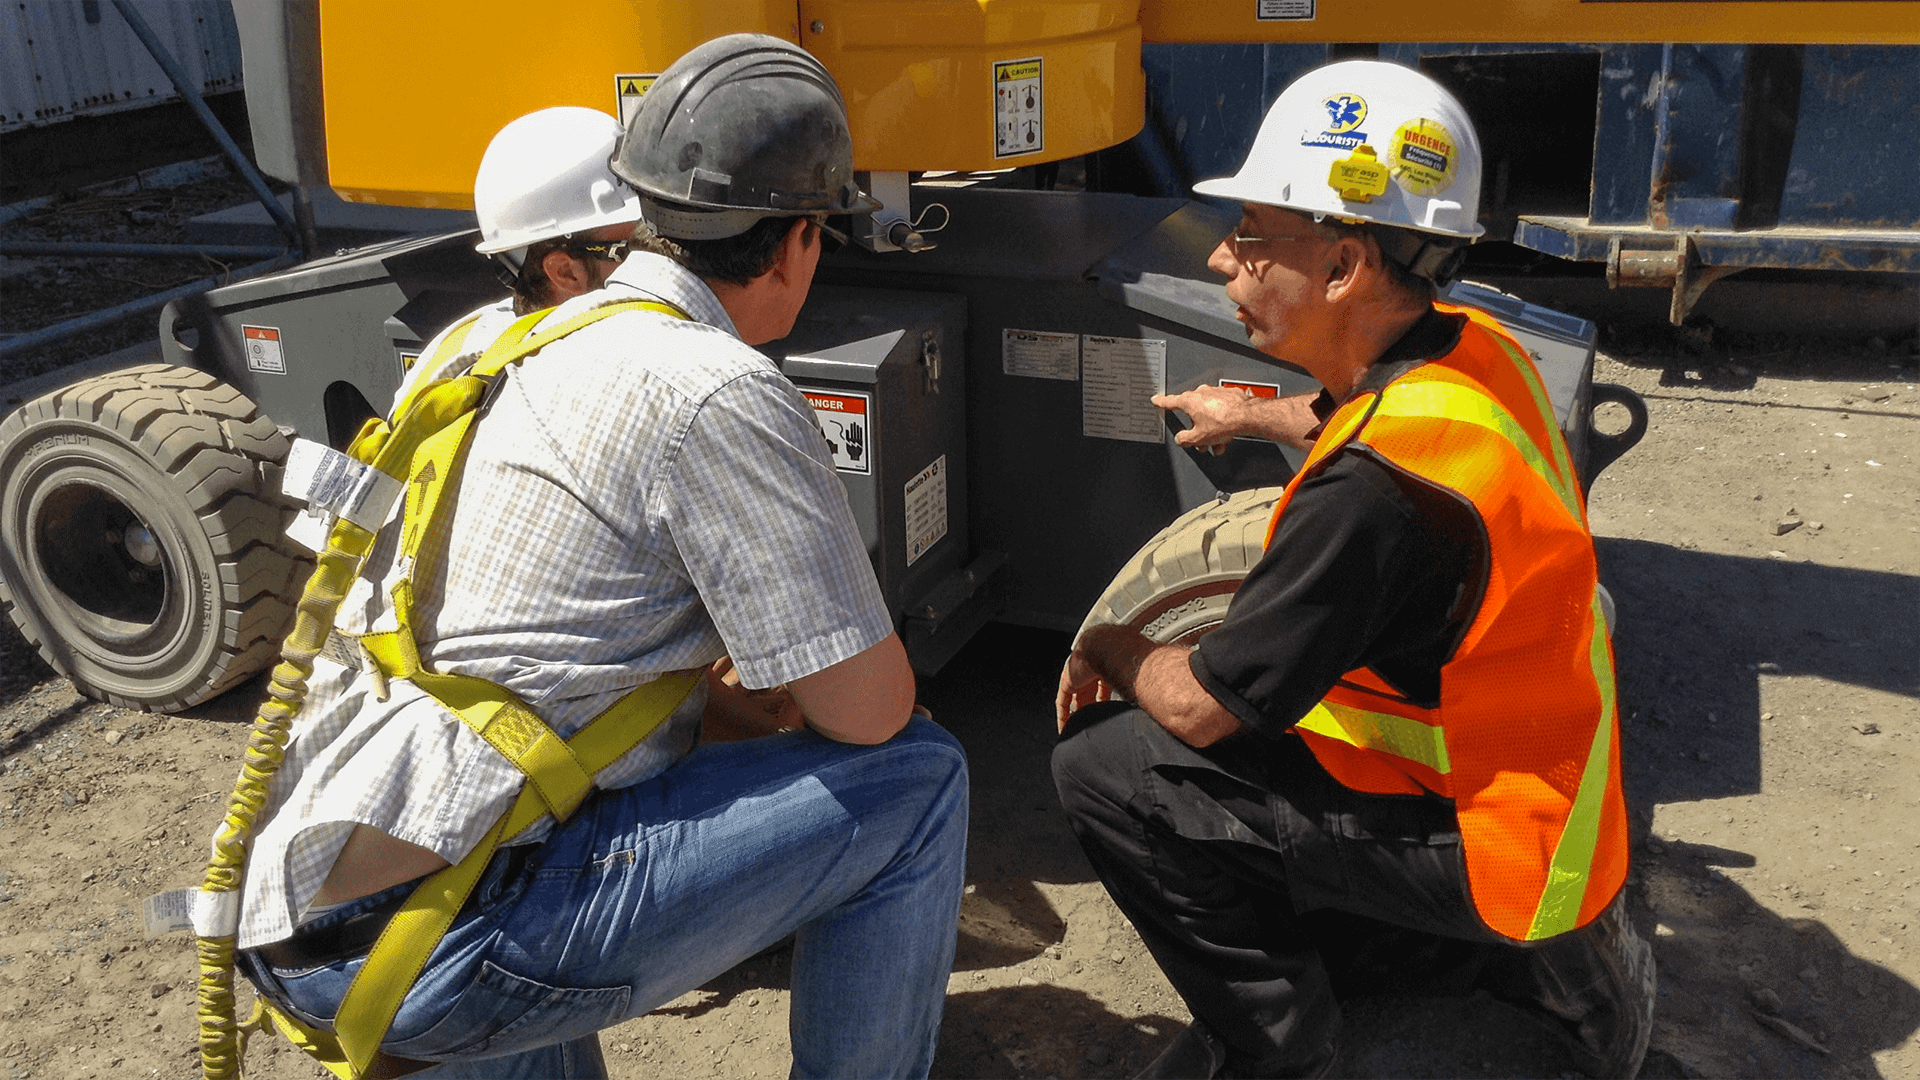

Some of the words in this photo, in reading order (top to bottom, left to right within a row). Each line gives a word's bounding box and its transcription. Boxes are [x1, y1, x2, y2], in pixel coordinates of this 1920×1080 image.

[1011, 67, 1039, 76] CAUTION
[1404, 130, 1451, 156] URGENCE
[808, 398, 844, 410] ANGER
[24, 433, 90, 458] MAGNUM
